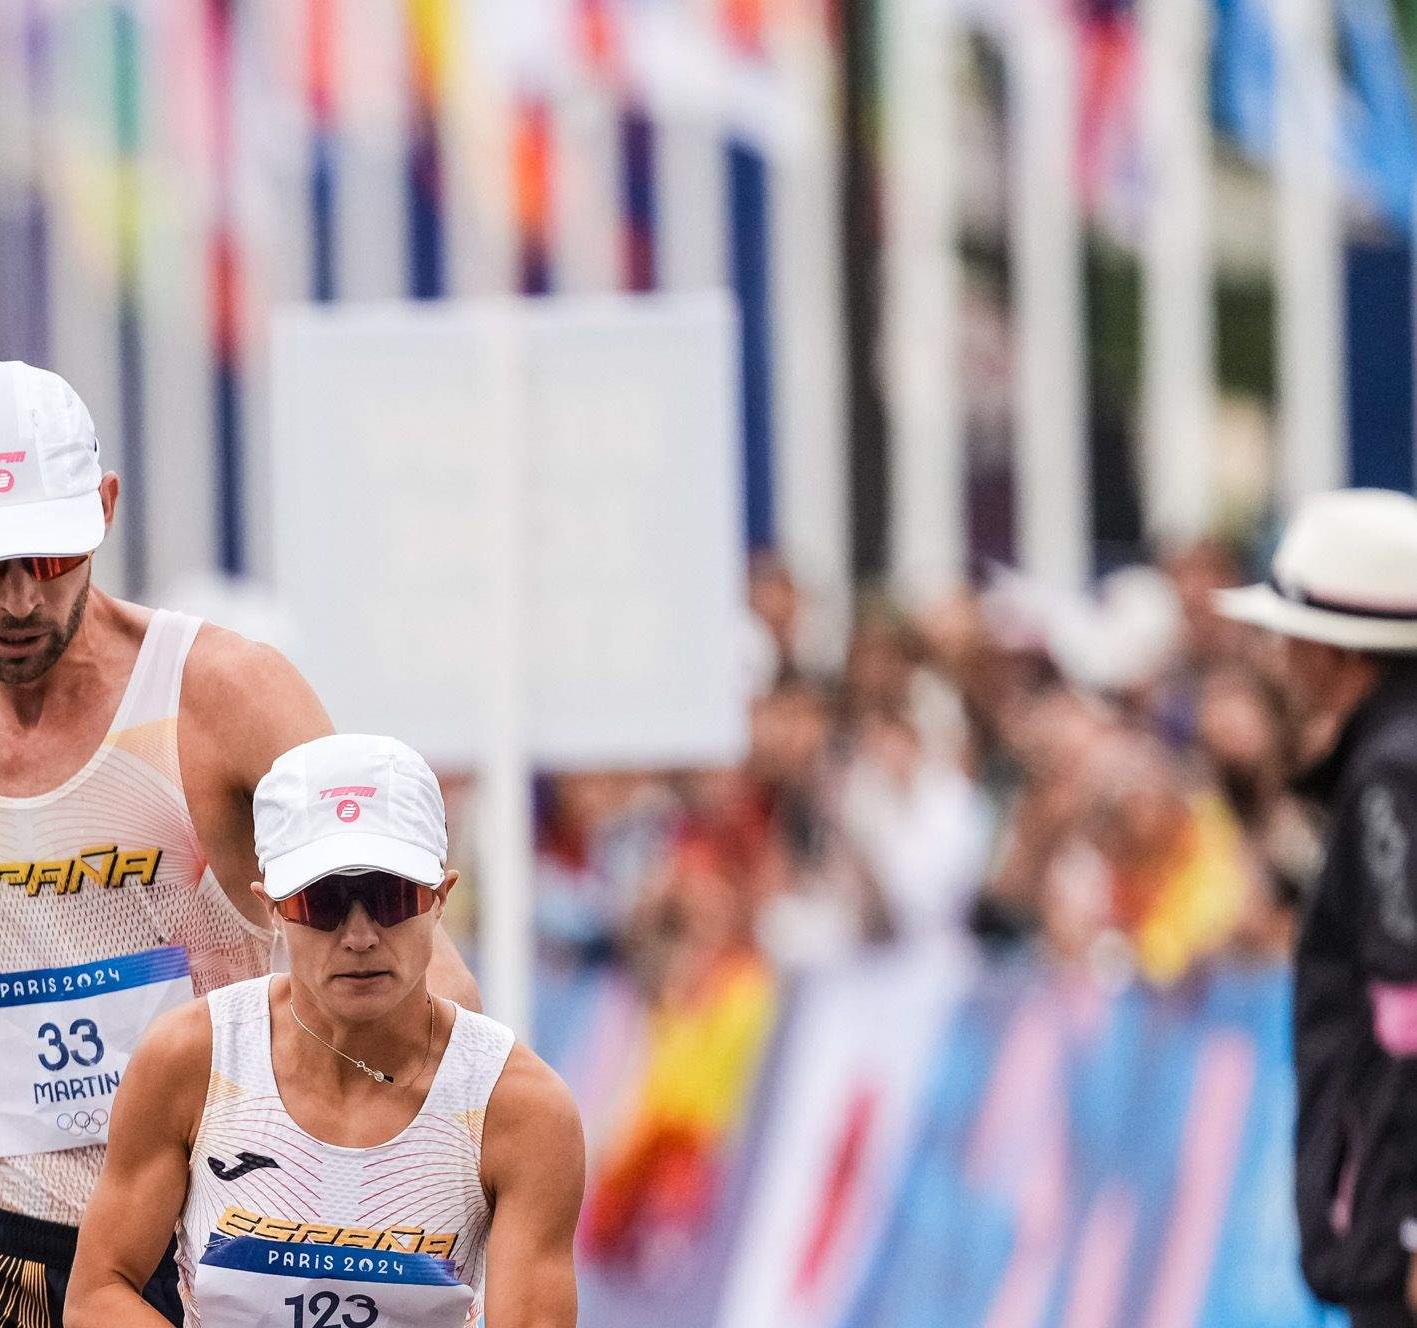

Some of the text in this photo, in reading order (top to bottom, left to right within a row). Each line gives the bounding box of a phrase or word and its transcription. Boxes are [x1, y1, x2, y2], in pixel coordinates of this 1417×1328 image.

[0, 968, 121, 999] PARIS 2024
[37, 1018, 105, 1072] 33
[33, 1070, 120, 1104] MARTIN
[217, 1206, 460, 1260] ESPAÑA
[268, 1250, 404, 1275] PARIS 2024
